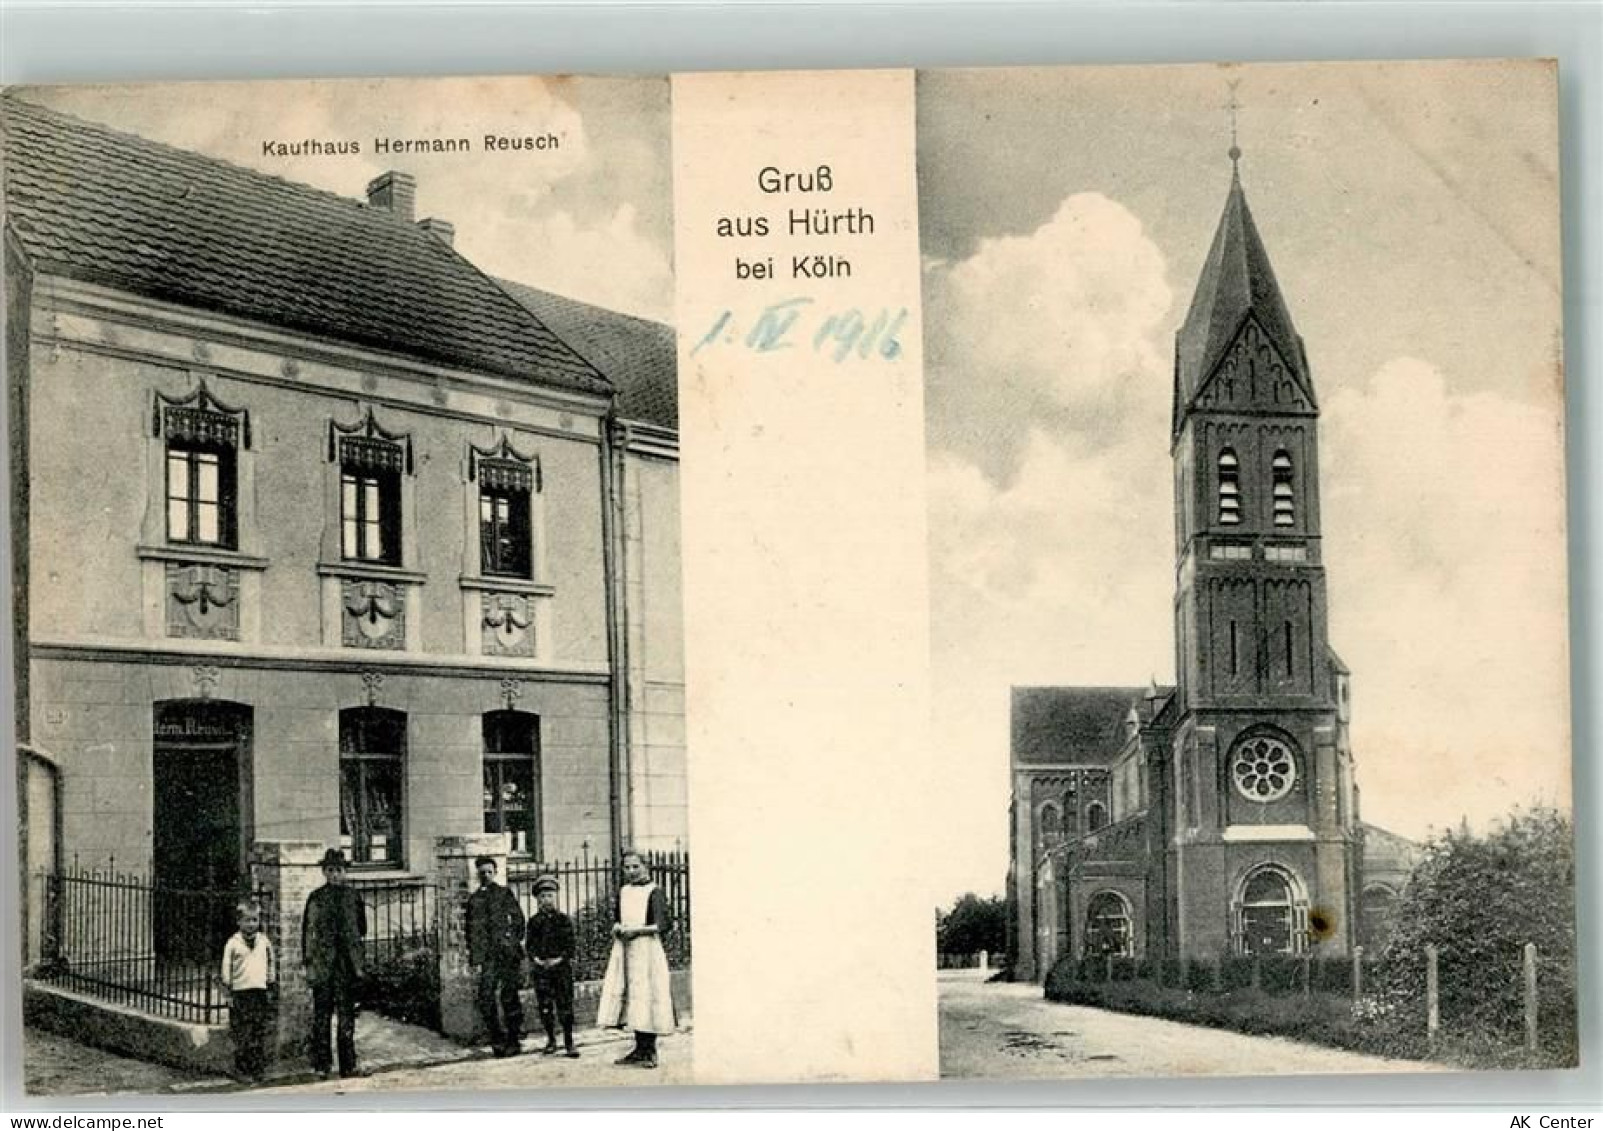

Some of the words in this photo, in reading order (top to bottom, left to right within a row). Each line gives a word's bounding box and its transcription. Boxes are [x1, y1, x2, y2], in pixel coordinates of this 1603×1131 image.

[263, 139, 361, 156] Kaufhaus
[374, 137, 471, 154] Hermann
[483, 134, 560, 151] Reusch
[758, 165, 833, 193] Gruß
[717, 217, 770, 236] aus
[788, 208, 874, 235] Hürth
[736, 257, 773, 279] bei
[792, 256, 851, 278] Köln
